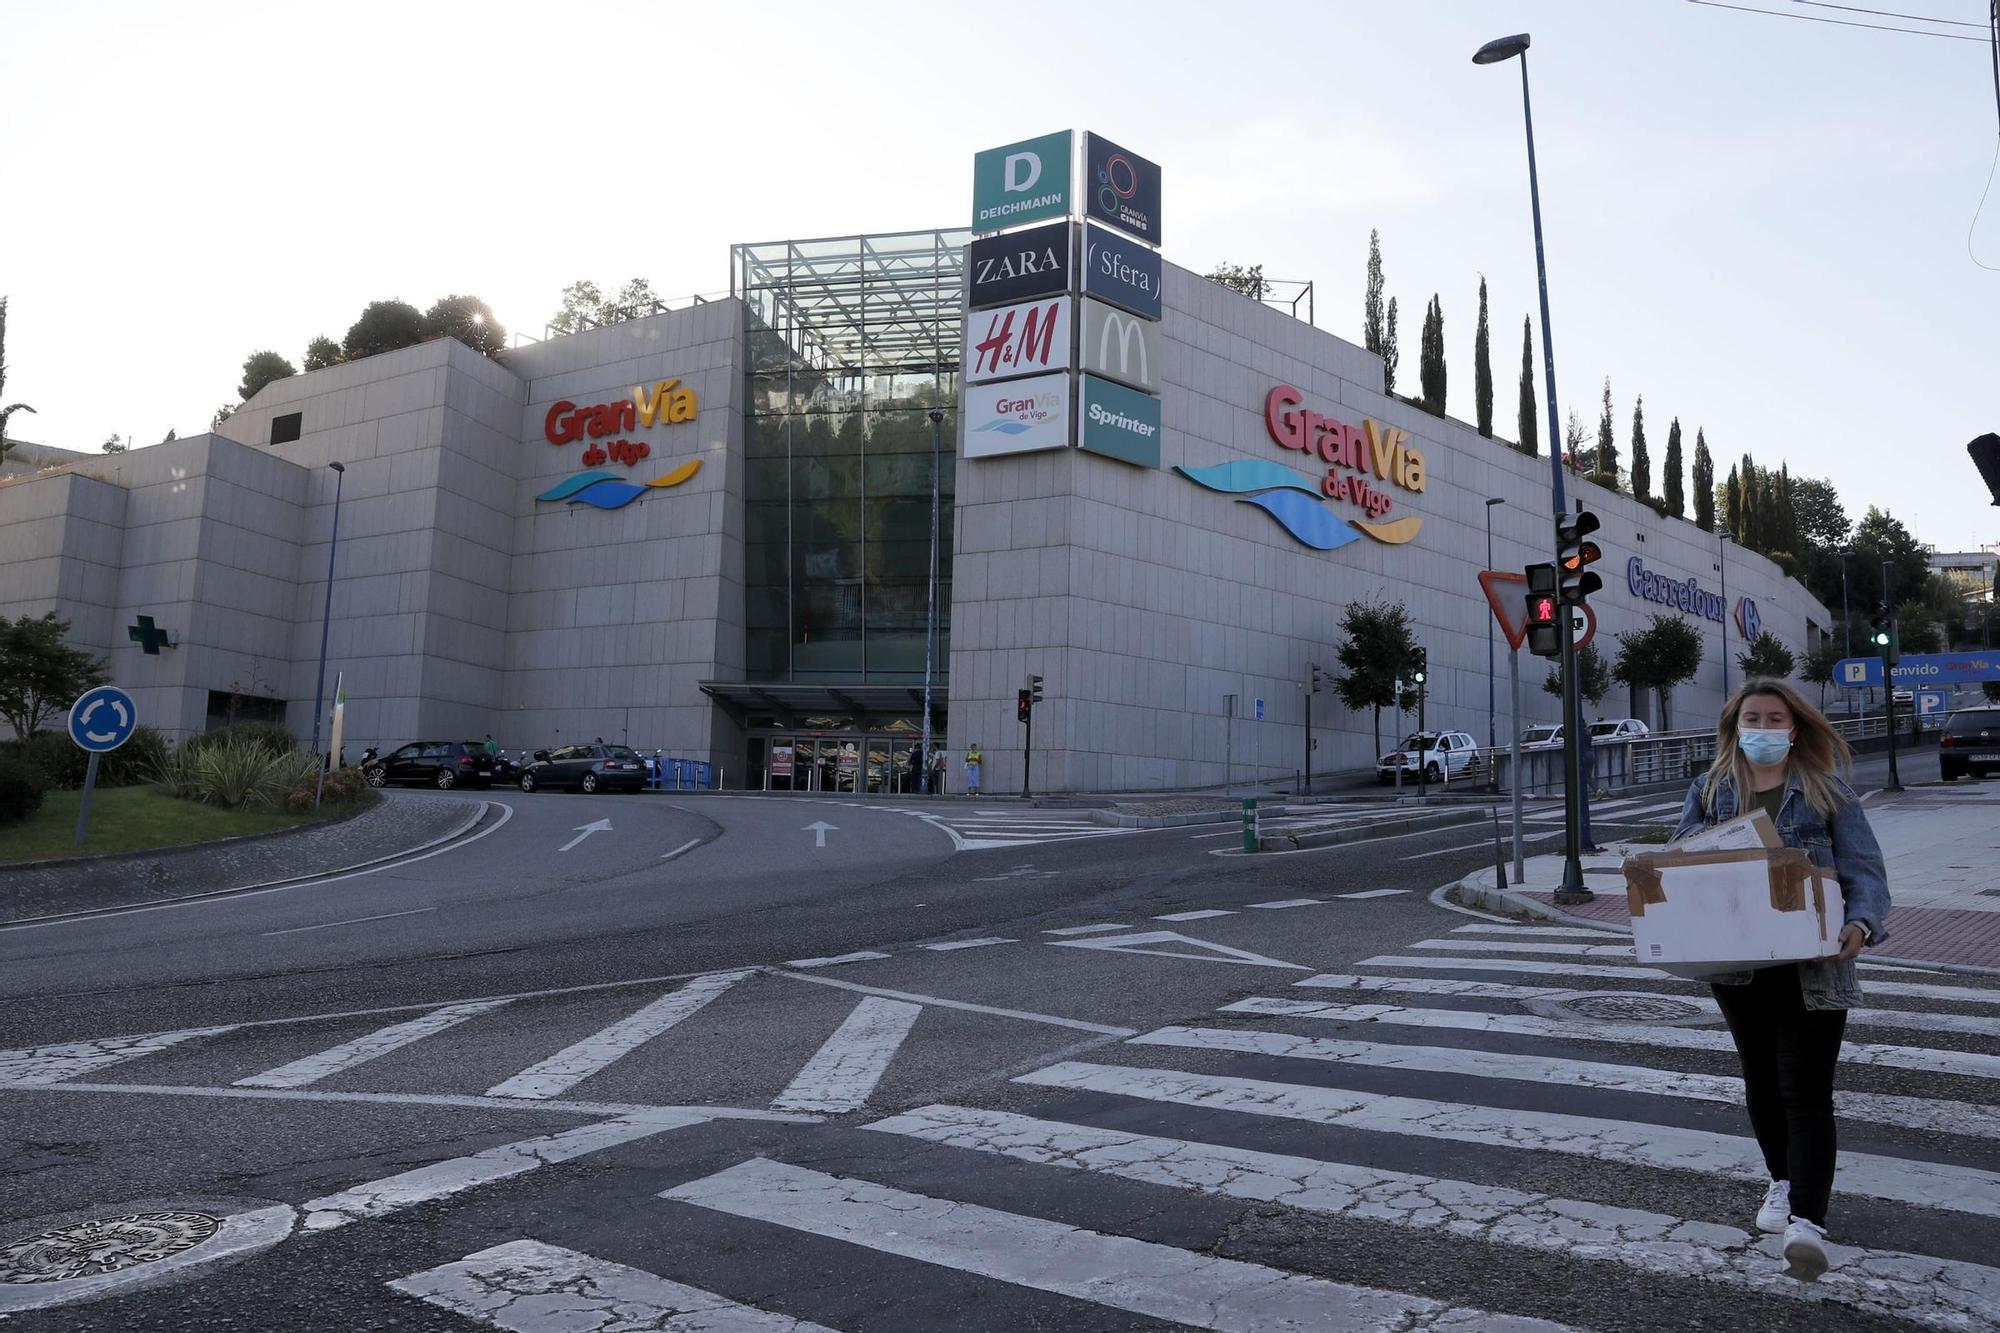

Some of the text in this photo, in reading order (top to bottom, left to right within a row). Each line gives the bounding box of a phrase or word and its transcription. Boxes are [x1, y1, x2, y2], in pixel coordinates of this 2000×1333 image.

[980, 193, 1062, 220] DEICHMANN
[1120, 213, 1147, 231] CINES
[976, 247, 1061, 284] ZARA
[976, 302, 1059, 373] H&M
[1029, 411, 1047, 420] Vigo
[1089, 403, 1155, 437] Sprinter
[582, 439, 650, 466] de Vigo
[1321, 468, 1392, 518] de Vigo
[1628, 556, 1727, 623] Carrefour
[1852, 666, 1860, 679] P
[1881, 664, 1939, 677] envido
[1920, 695, 1940, 713] P
